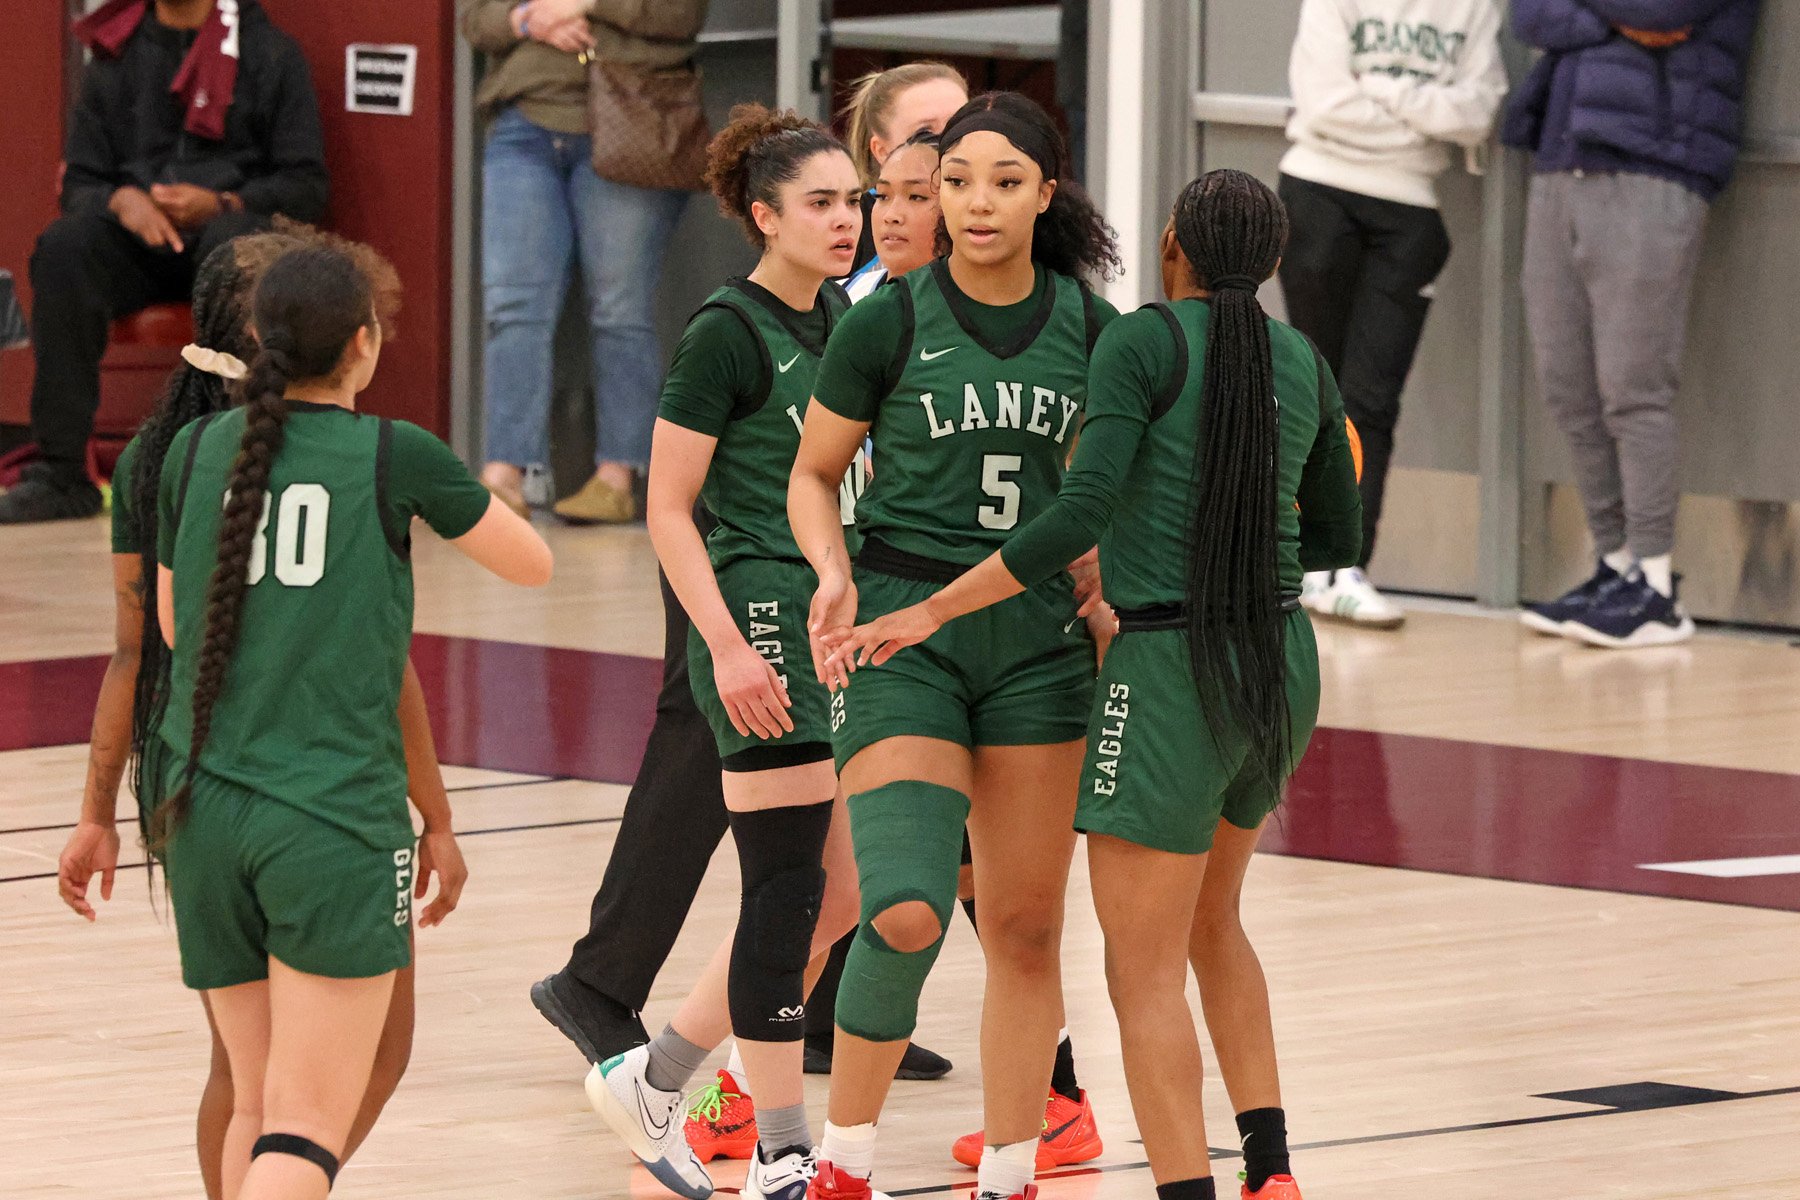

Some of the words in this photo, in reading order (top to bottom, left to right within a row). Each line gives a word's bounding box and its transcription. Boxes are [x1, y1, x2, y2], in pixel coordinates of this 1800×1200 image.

[919, 380, 1078, 444] LANEY
[977, 454, 1022, 530] 5
[748, 600, 789, 690] EAG
[1094, 683, 1130, 797] EAGLES
[393, 848, 411, 927] GLES
